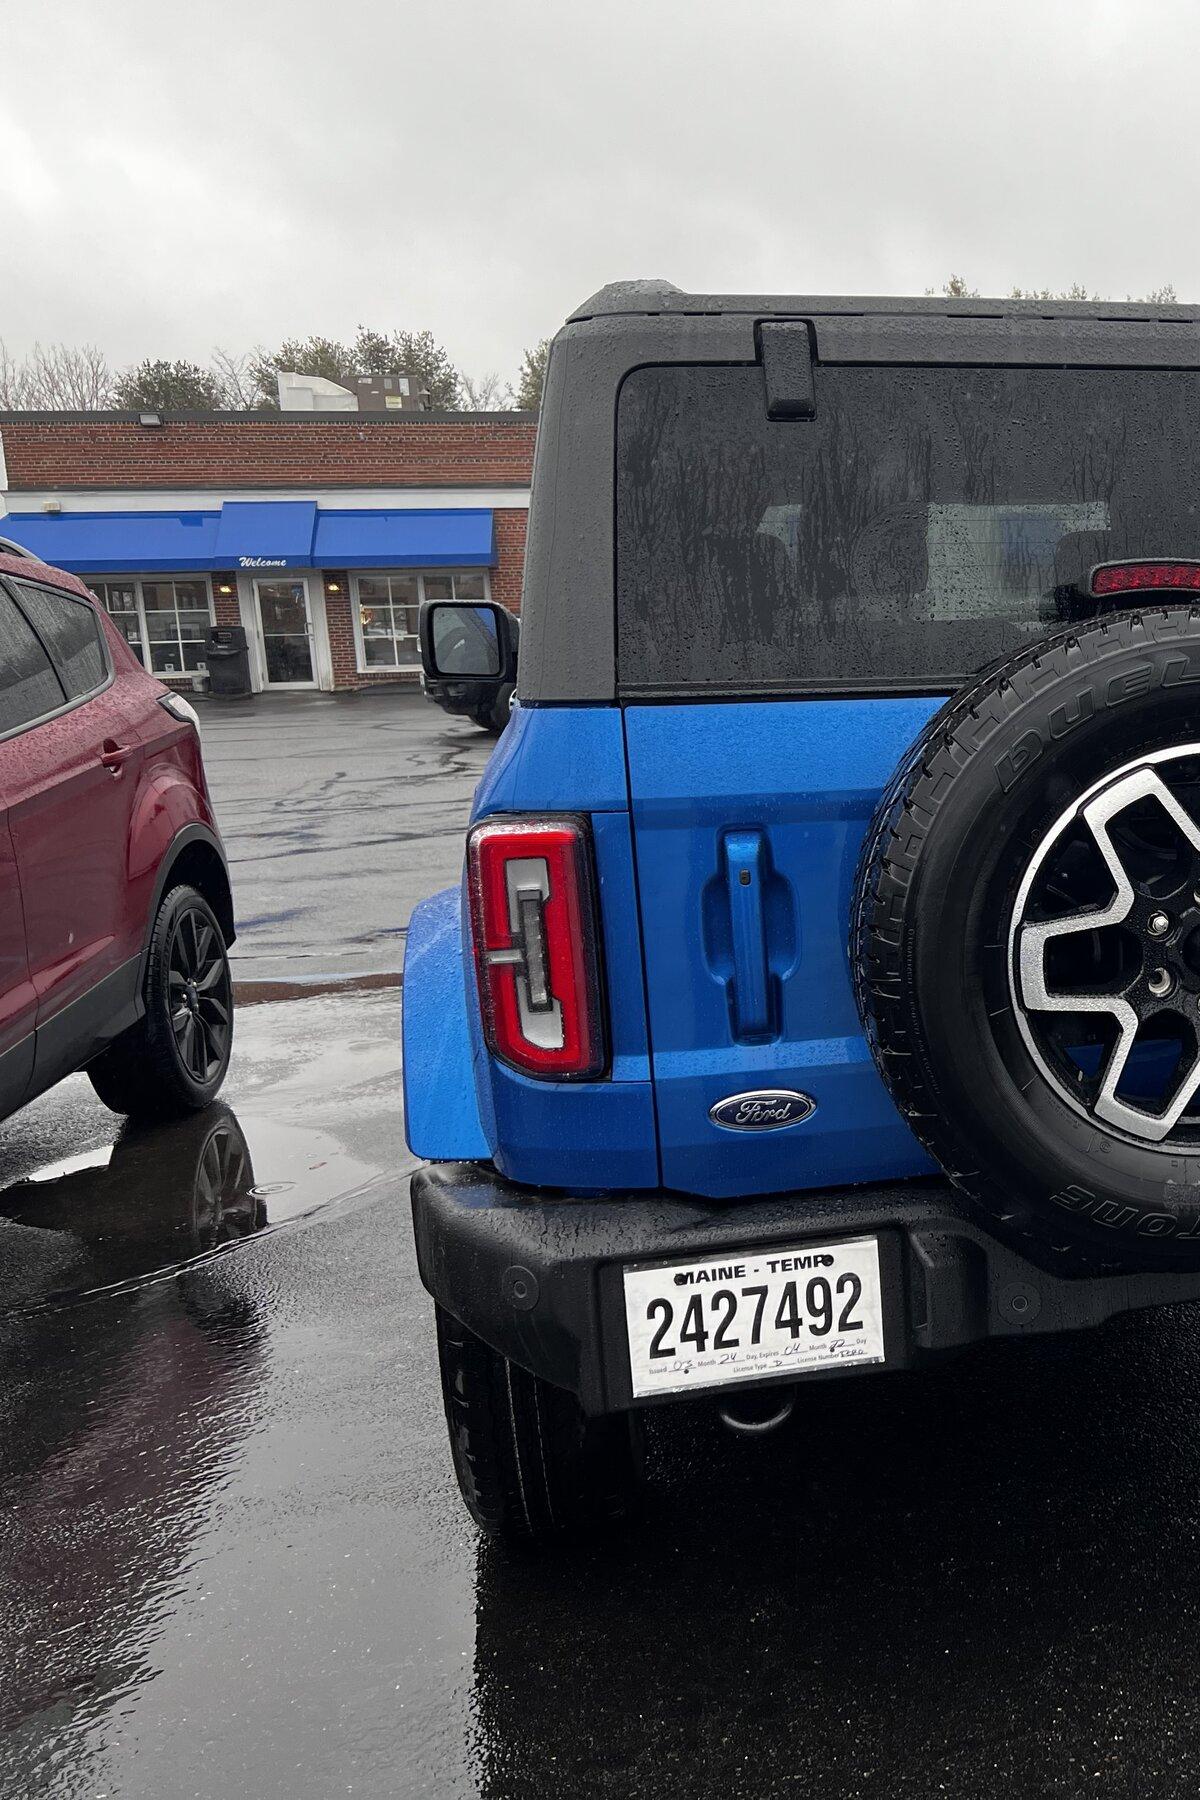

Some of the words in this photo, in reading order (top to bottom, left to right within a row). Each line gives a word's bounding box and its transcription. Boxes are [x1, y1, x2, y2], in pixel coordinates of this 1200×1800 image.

[239, 557, 287, 567] Welcome
[735, 1100, 791, 1123] Ford
[676, 1265, 746, 1286] MAINE
[766, 1254, 826, 1274] TEMP
[646, 1272, 864, 1360] 2427492
[649, 1366, 668, 1375] Issued
[698, 1359, 717, 1367] Month
[719, 1352, 738, 1365] 24
[759, 1350, 780, 1359] Expires
[809, 1343, 827, 1351] Month
[733, 1364, 754, 1373] License
[755, 1362, 768, 1371] Type
[797, 1353, 817, 1363] License
[818, 1351, 840, 1361] Number
